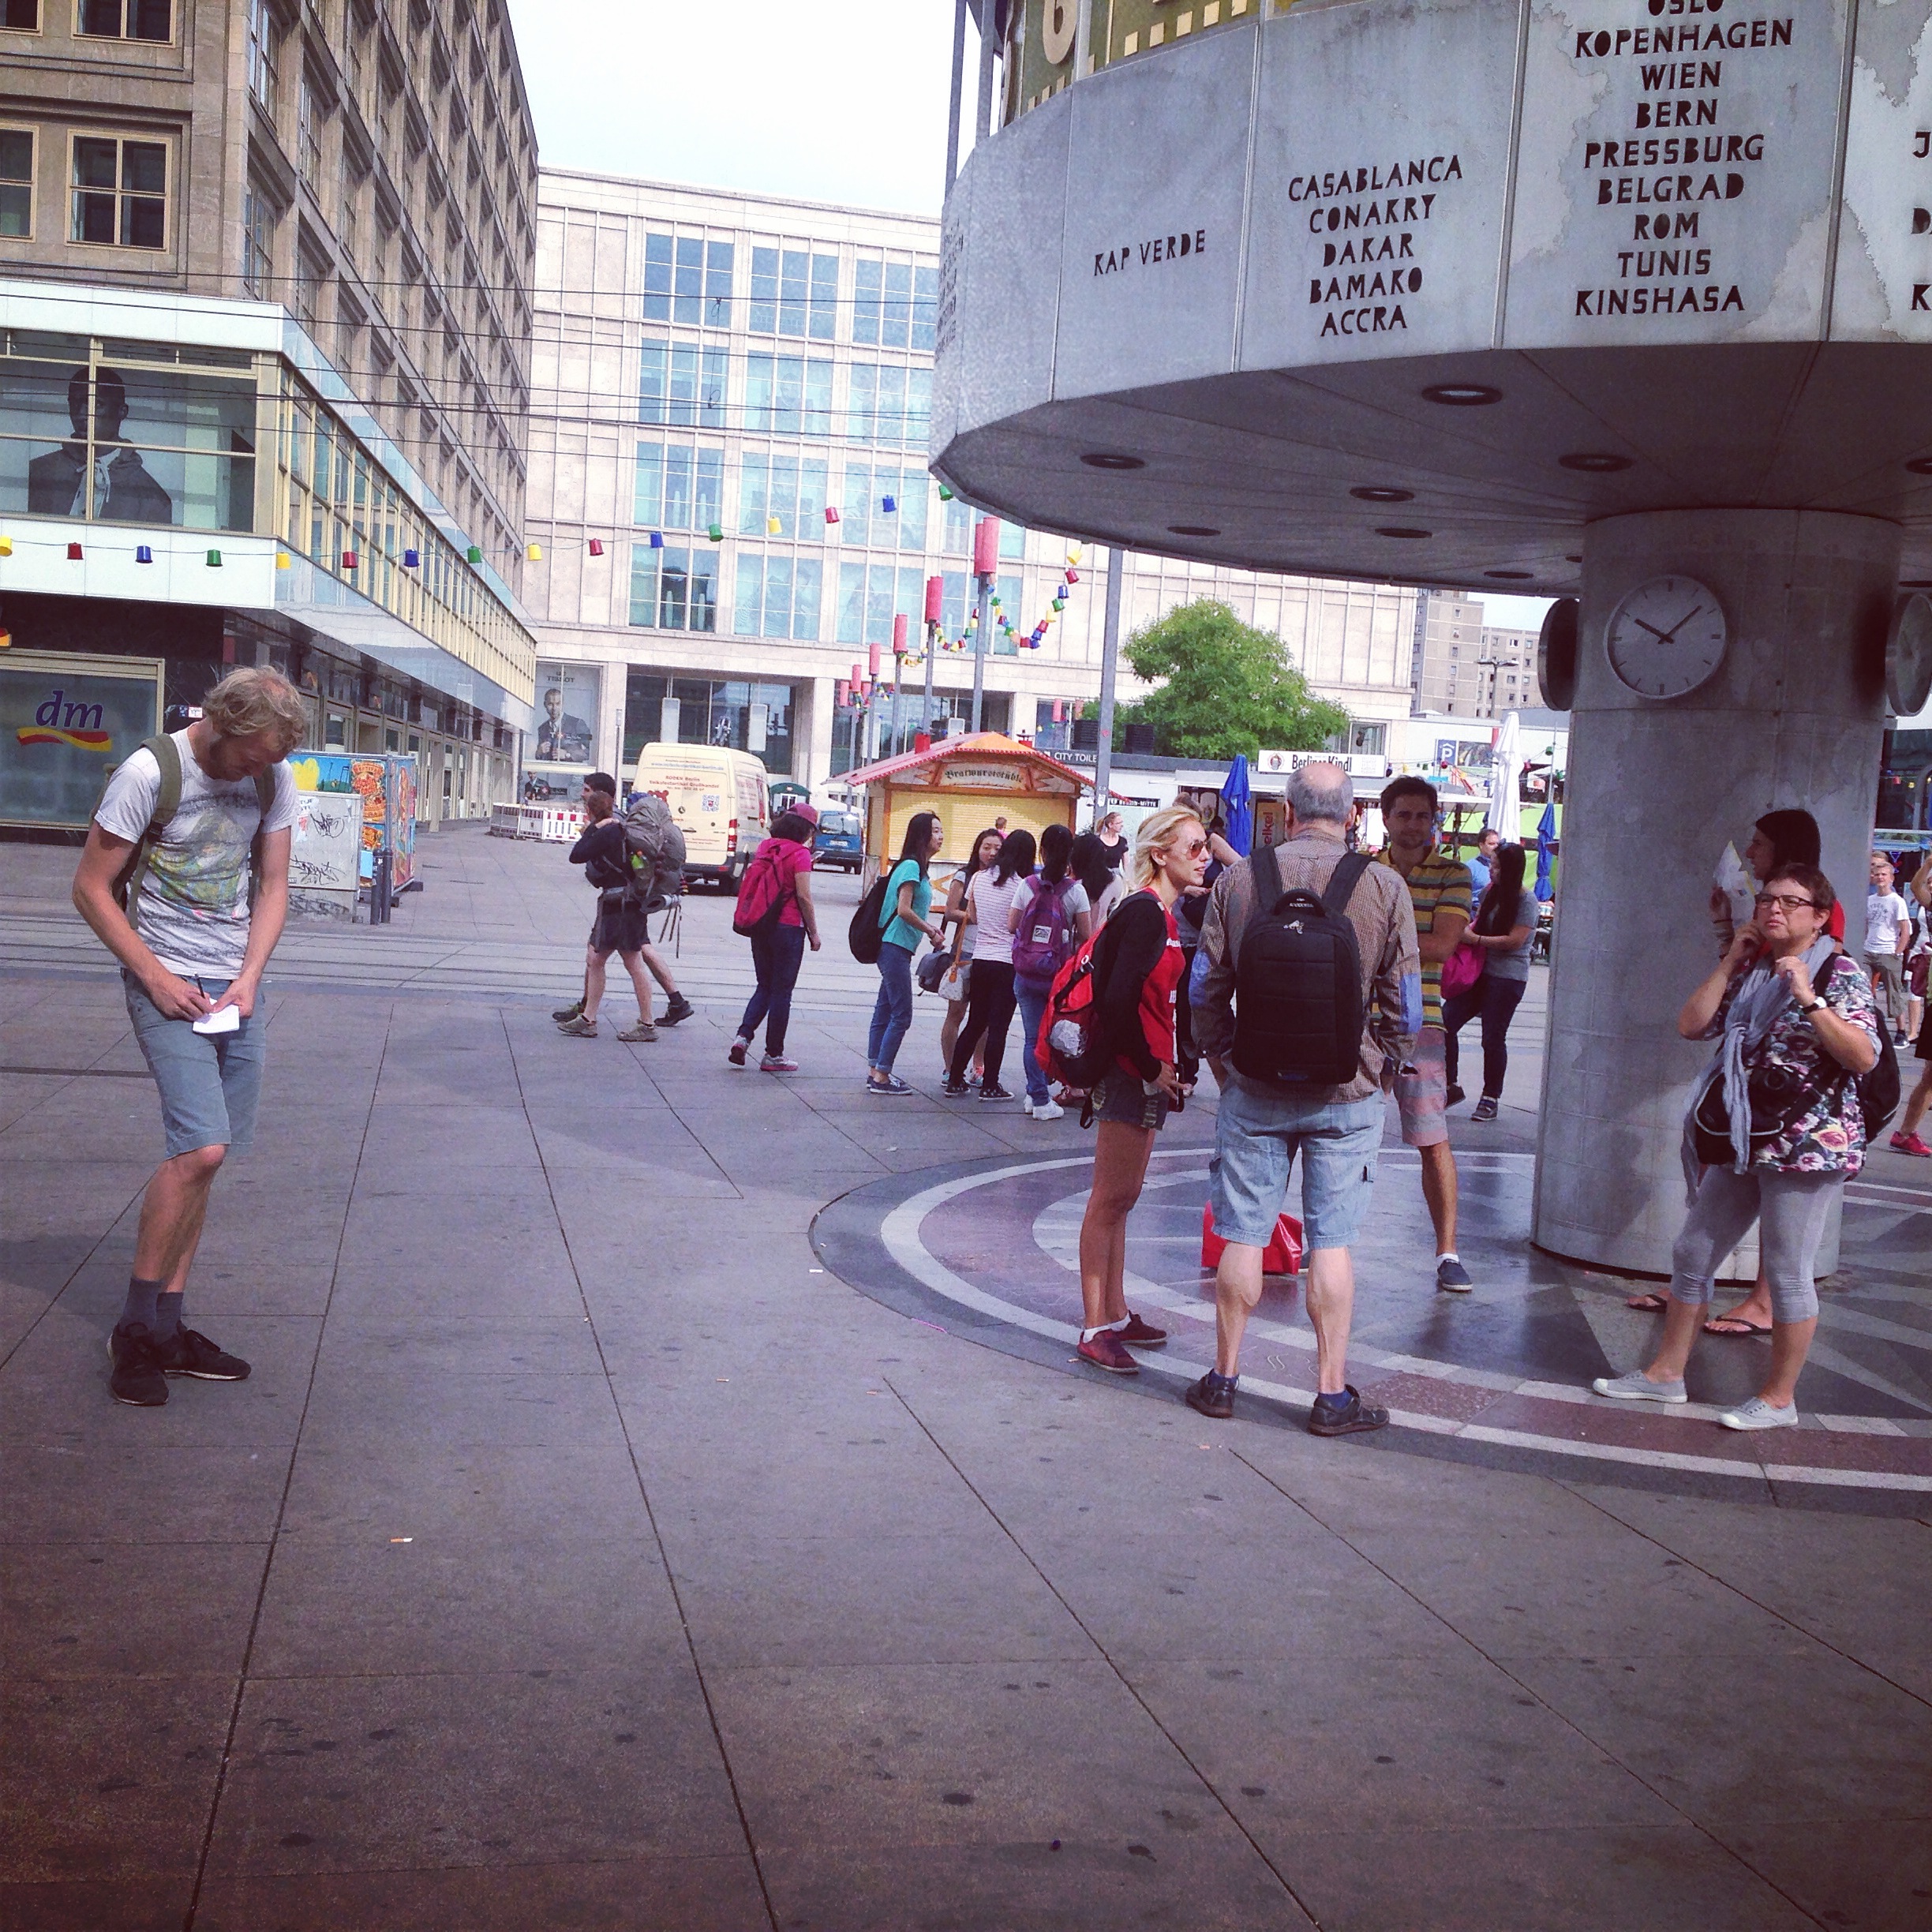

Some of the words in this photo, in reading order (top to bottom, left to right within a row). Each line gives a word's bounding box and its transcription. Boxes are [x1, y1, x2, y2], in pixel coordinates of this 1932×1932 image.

[1649, 0, 1724, 17] OSLO
[1575, 18, 1794, 58] KOPENHAGEN
[1641, 61, 1721, 92] WIEN
[1635, 99, 1718, 129] BERN
[1584, 133, 1765, 169] PRESSBURG
[1288, 155, 1462, 203] CASABLANCA
[1597, 173, 1744, 205] BELGRAD
[1309, 194, 1436, 234] CONAKRY
[1633, 212, 1699, 241] ROM
[1094, 247, 1130, 276] KAP
[1140, 229, 1205, 265] VERDE
[1323, 233, 1414, 269] DAKAR
[1617, 249, 1711, 278] TUNIS
[1309, 265, 1423, 304] BAMAKO
[1575, 285, 1745, 316] KINSHASA
[1320, 305, 1407, 337] ACCRA
[36, 691, 103, 728] dm
[1054, 752, 1072, 762] CITY
[1075, 753, 1097, 763] TOILE
[1292, 754, 1327, 769] Berli
[1328, 755, 1352, 772] Kindl
